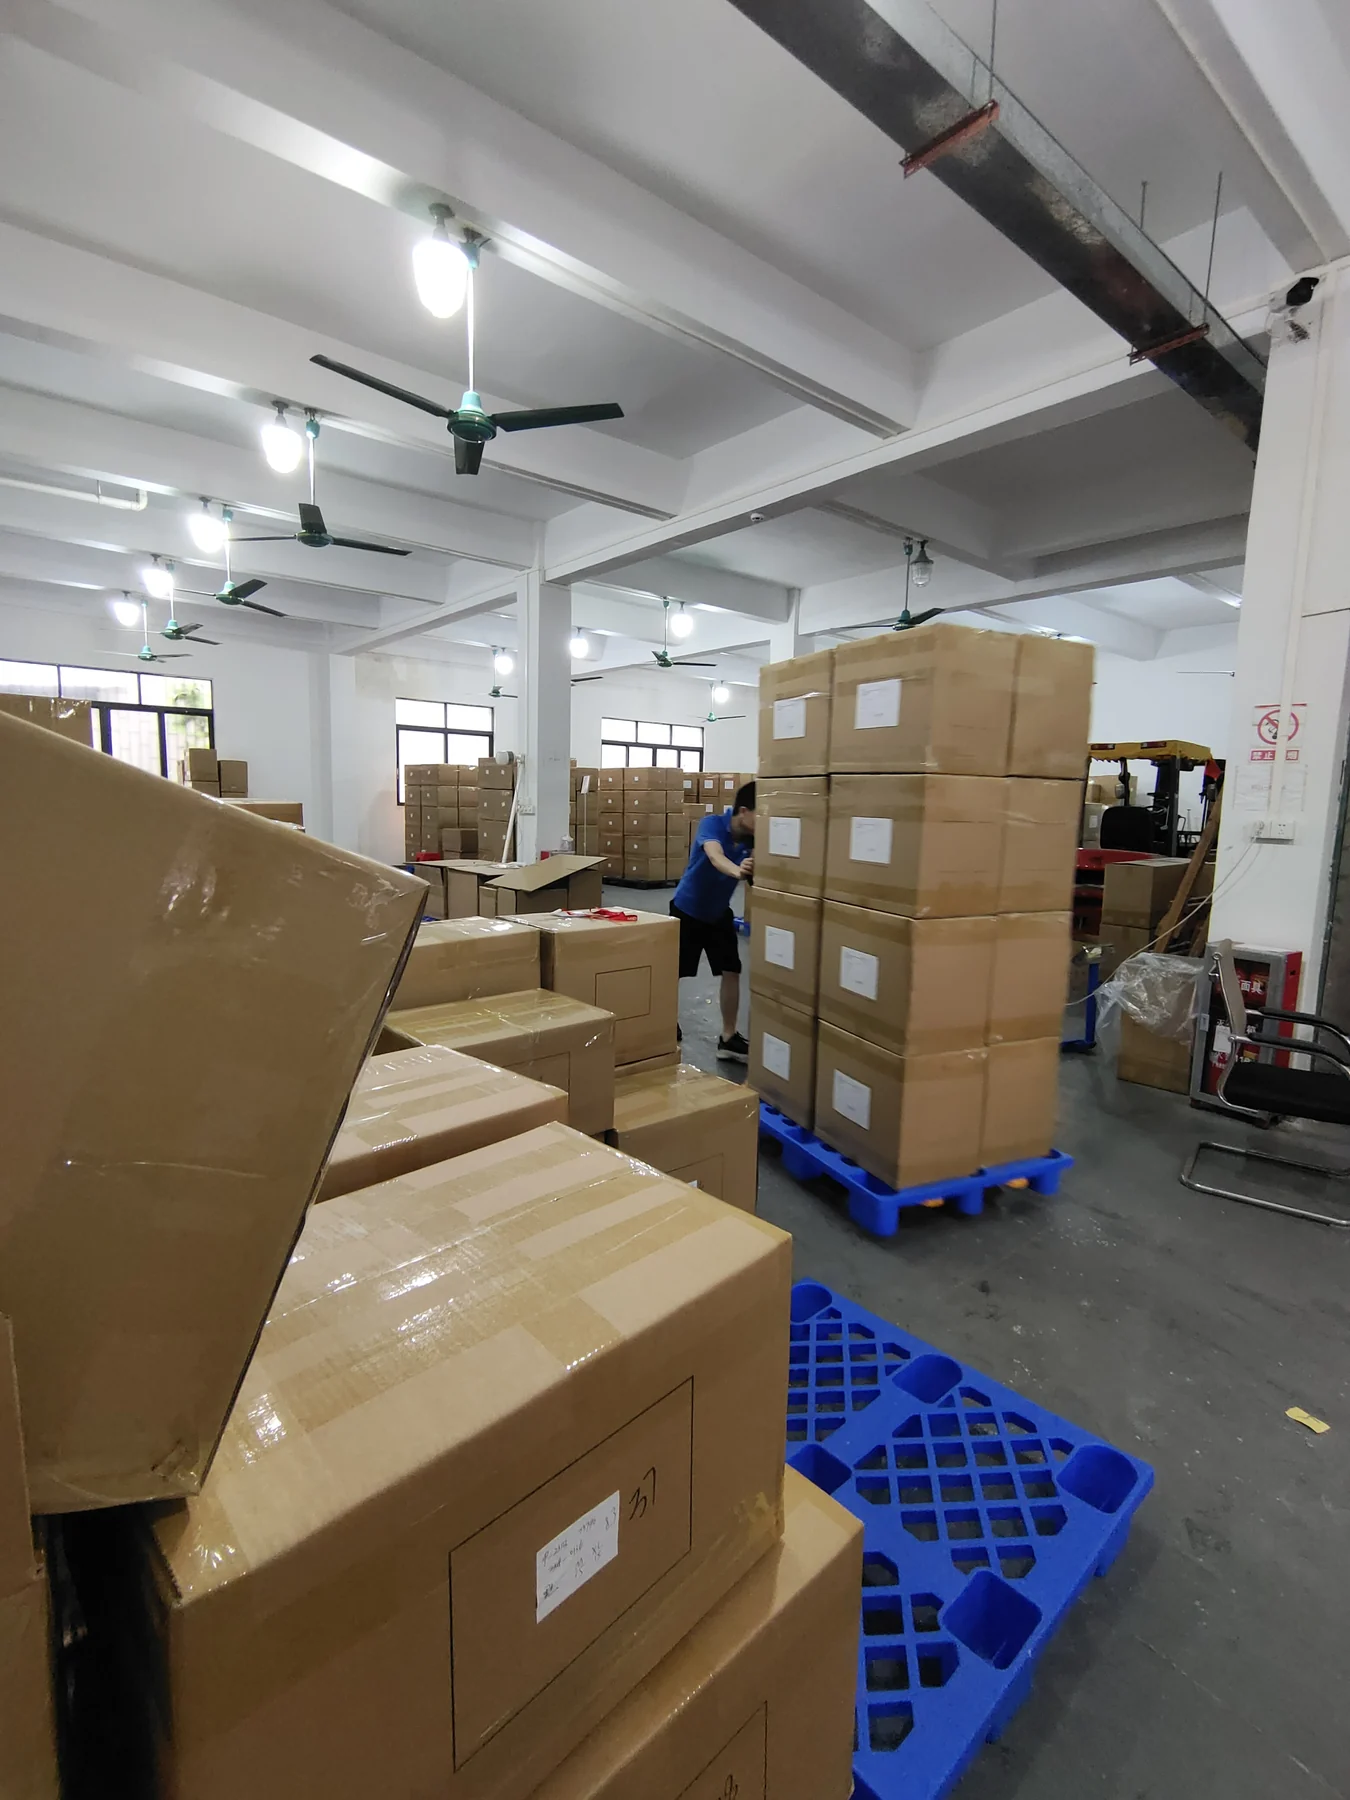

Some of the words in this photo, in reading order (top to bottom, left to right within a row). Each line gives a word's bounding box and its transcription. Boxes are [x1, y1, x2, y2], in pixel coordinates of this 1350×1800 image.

[1252, 751, 1298, 760] 禁止烟
[1239, 980, 1263, 995] 面具
